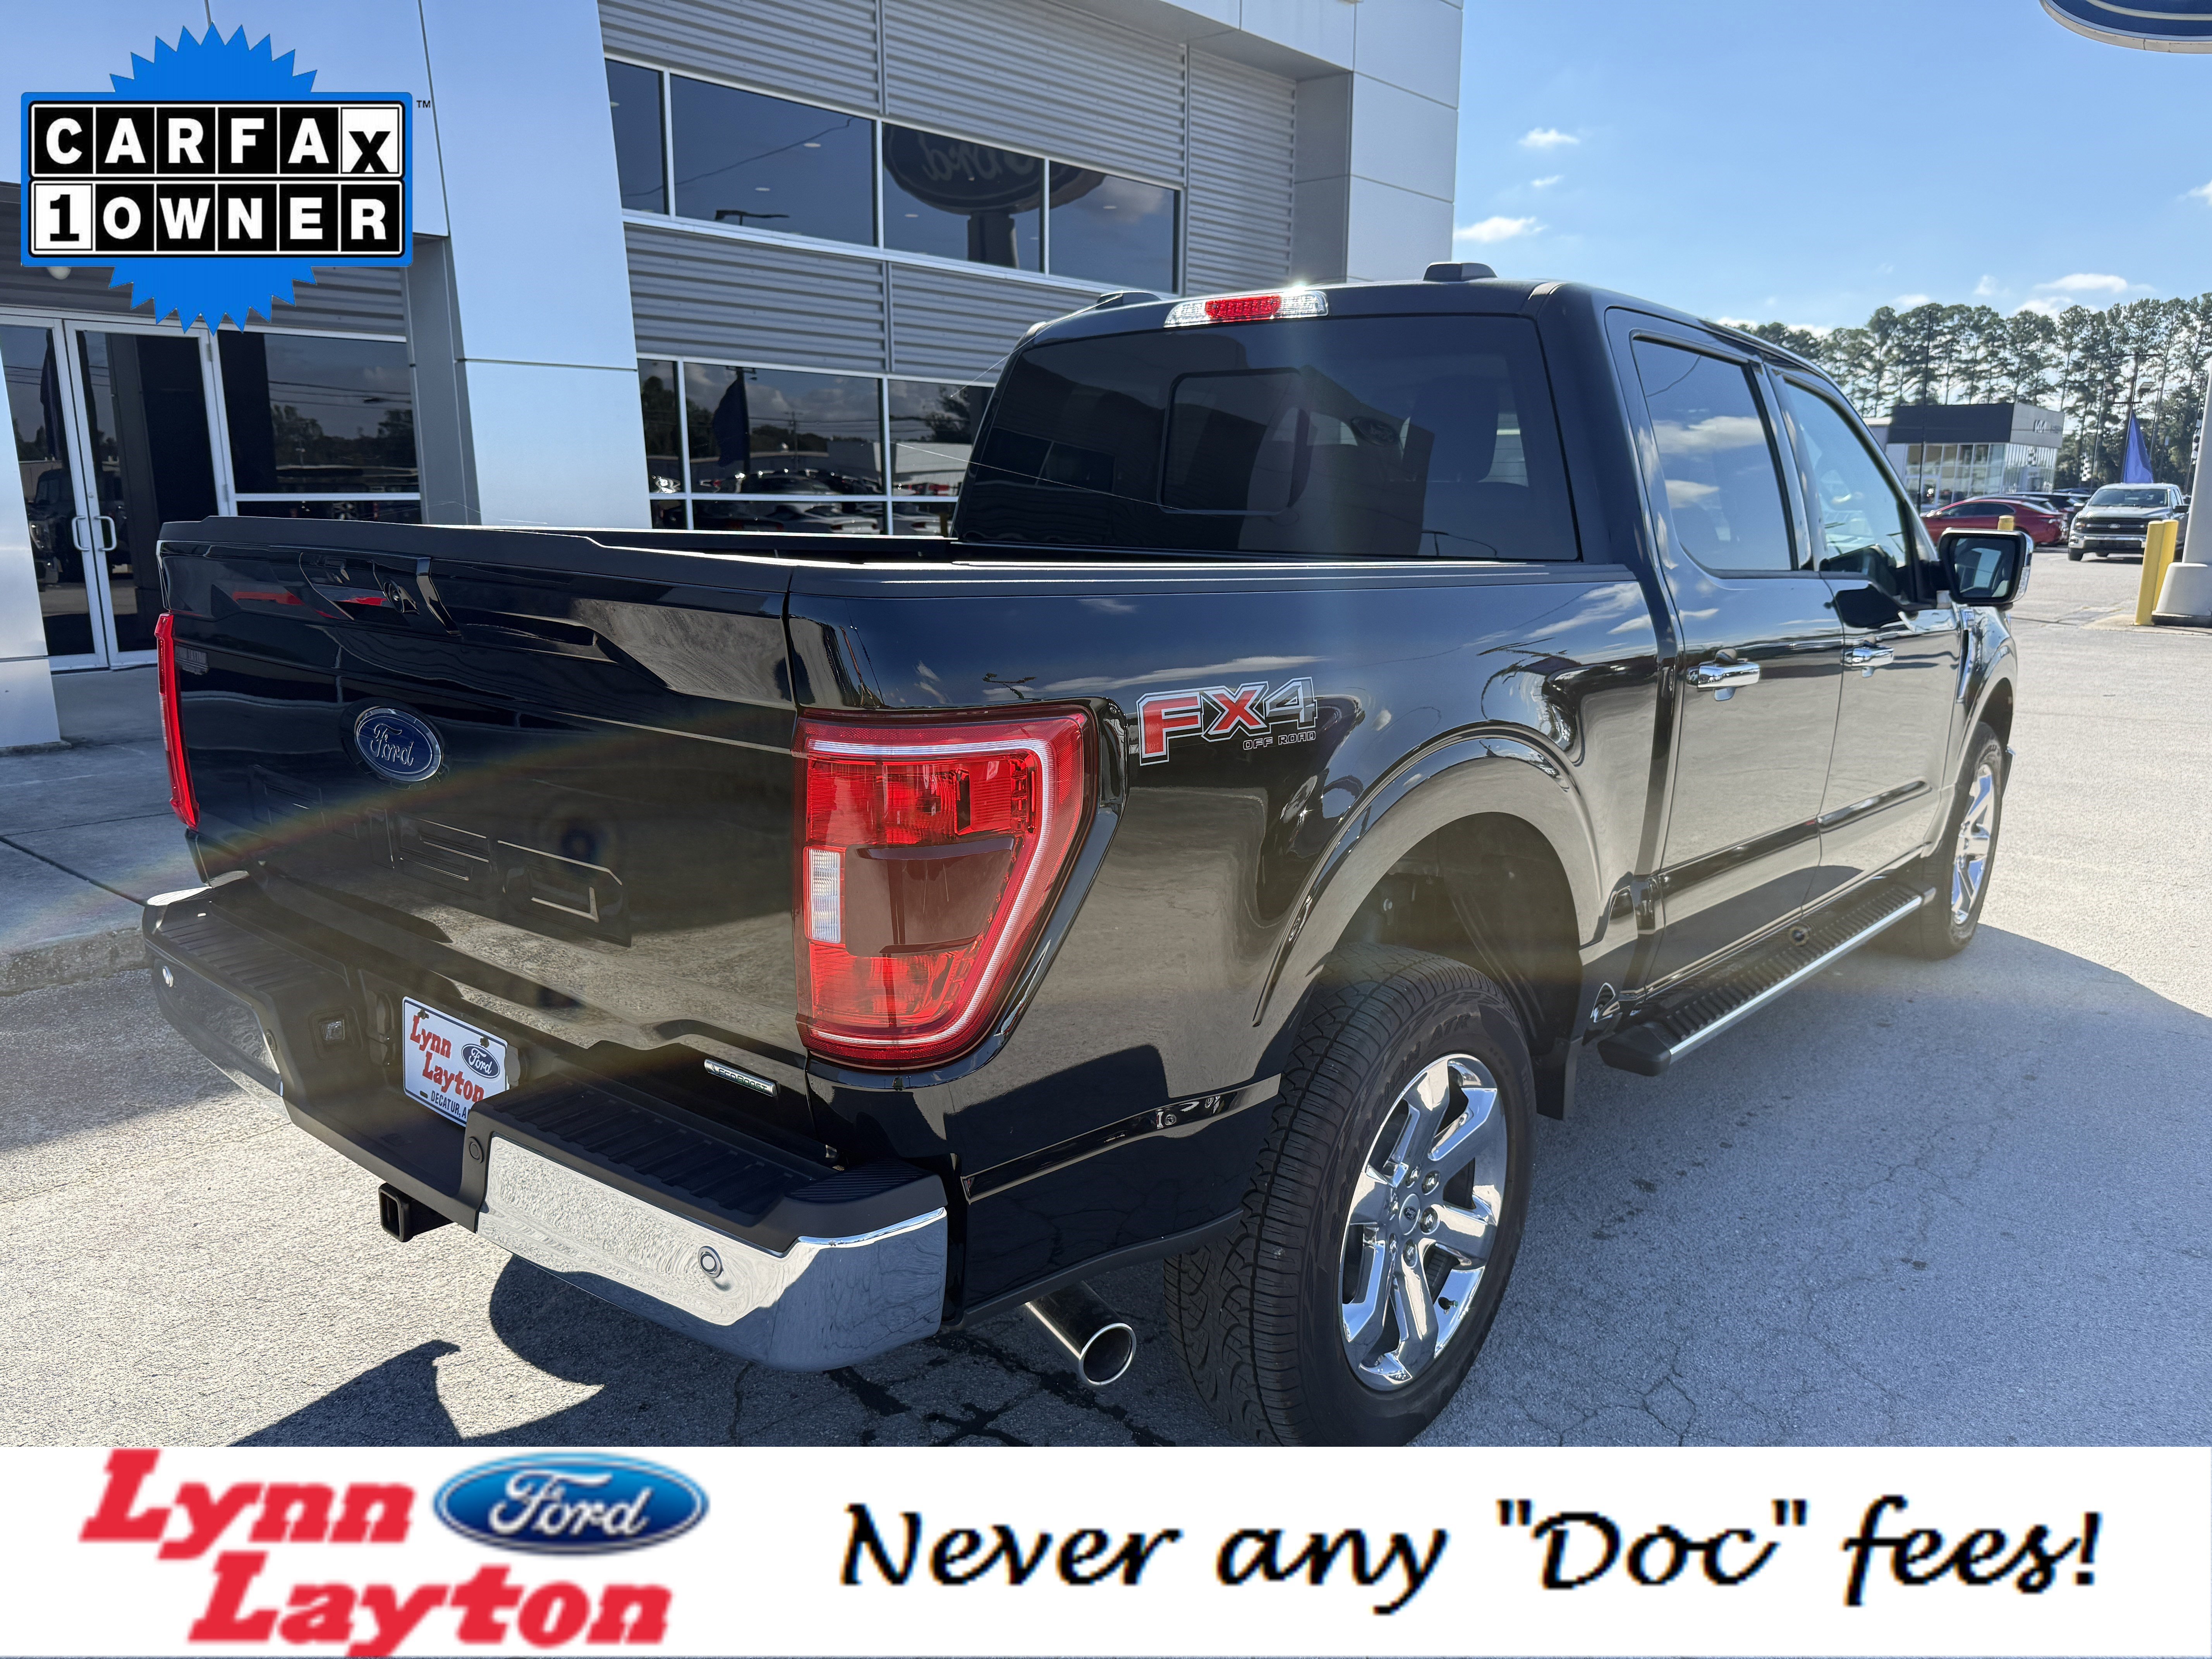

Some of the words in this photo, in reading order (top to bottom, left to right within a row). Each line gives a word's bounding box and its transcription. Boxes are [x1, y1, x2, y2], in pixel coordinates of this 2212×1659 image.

[1136, 677, 1318, 766] FX4
[1243, 737, 1273, 750] OFF
[1278, 731, 1316, 745] ROAD
[370, 723, 414, 766] Ford
[410, 1015, 452, 1059] Lynn
[422, 1051, 484, 1103] Layton
[468, 1048, 493, 1075] Ford
[431, 1090, 461, 1118] DECATUR,
